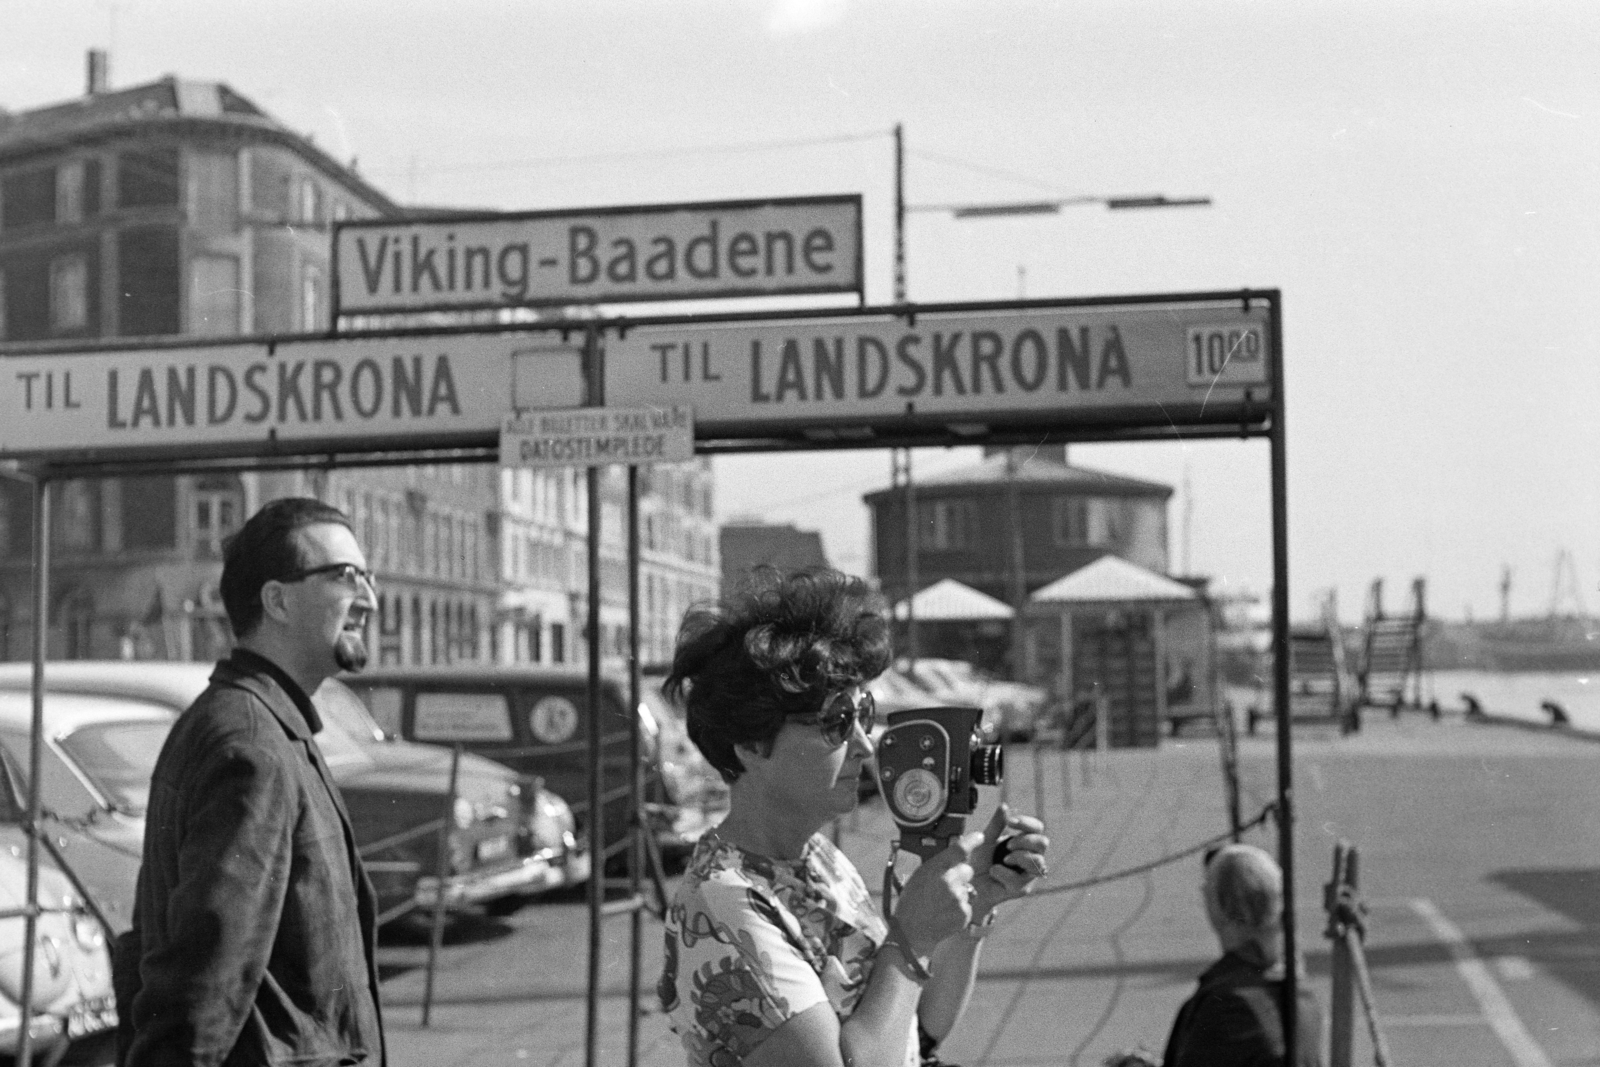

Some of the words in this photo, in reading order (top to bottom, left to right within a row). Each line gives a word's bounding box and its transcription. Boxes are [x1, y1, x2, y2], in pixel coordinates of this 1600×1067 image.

[356, 218, 834, 300] Viking-Baadene
[16, 371, 81, 410] TIL
[107, 354, 462, 430] LANDSKRONA
[651, 340, 721, 383] TIL
[751, 324, 1132, 404] LANDSKRONA
[519, 434, 666, 460] DATOSTEMPLEDE
